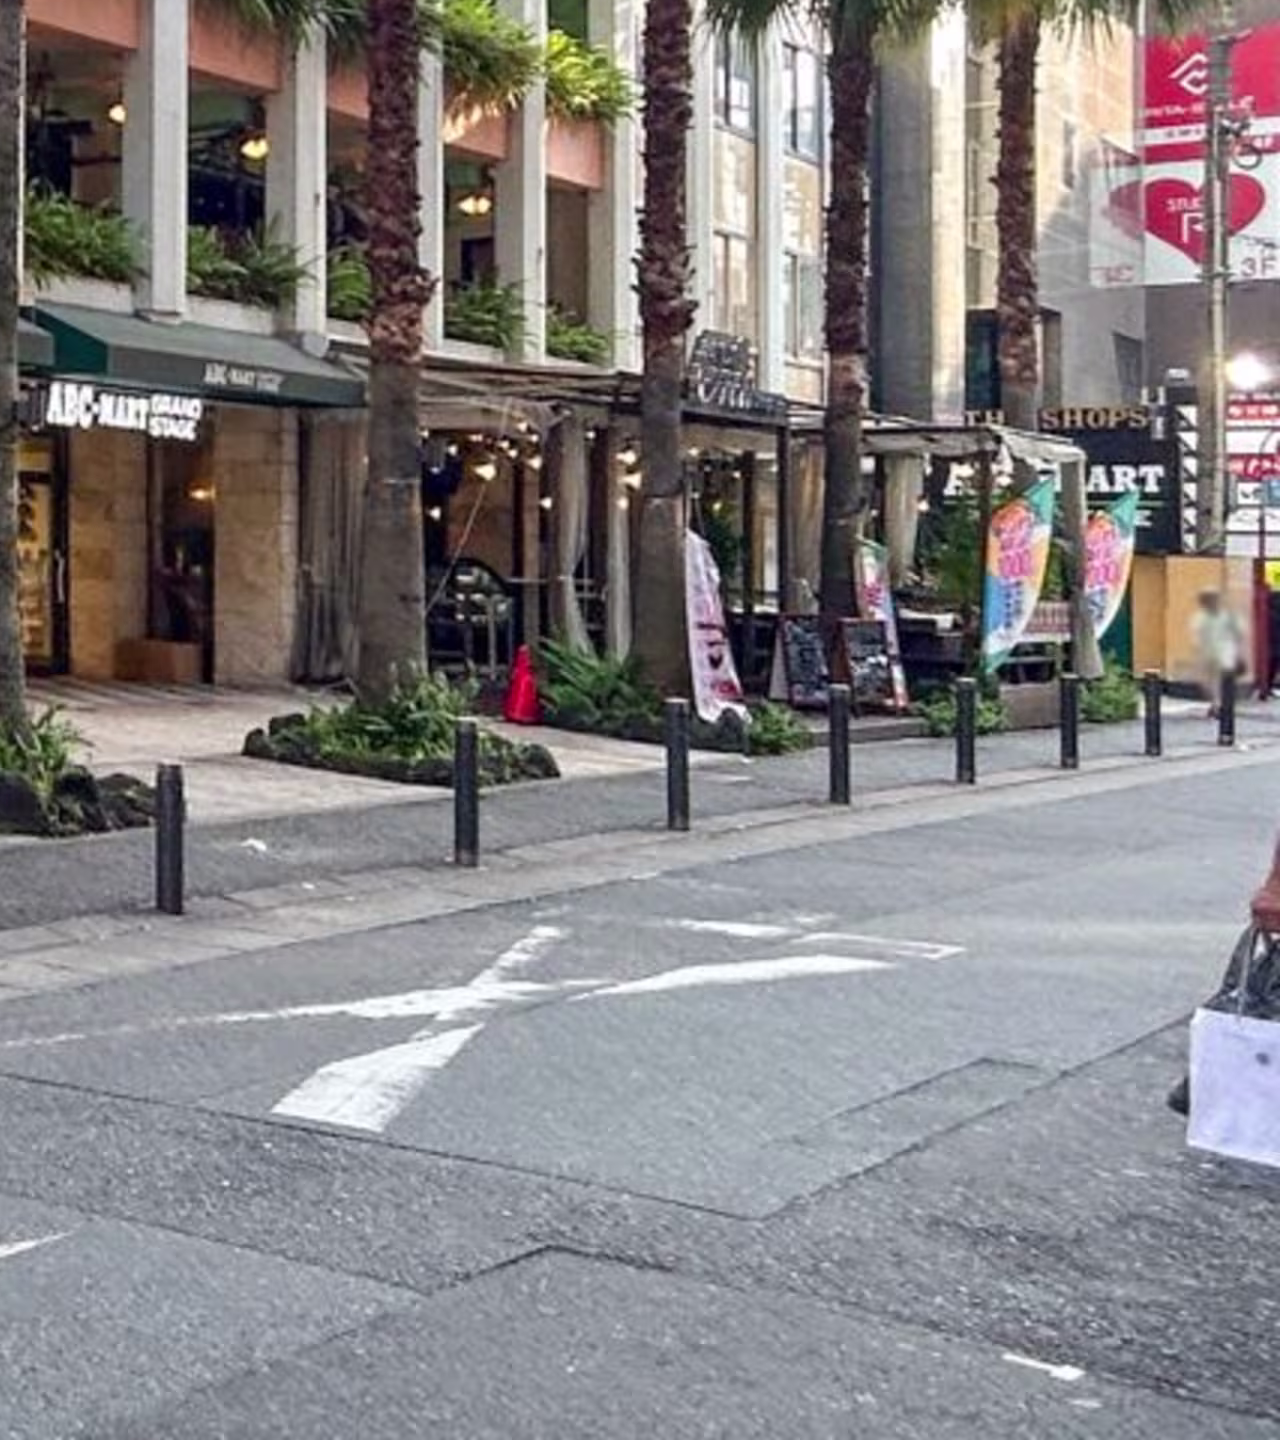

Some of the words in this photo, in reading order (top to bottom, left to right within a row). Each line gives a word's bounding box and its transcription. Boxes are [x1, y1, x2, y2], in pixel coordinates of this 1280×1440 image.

[151, 394, 202, 421] GRAND
[963, 409, 1005, 428] TH
[1040, 407, 1148, 431] SHOPS
[149, 417, 196, 441] STAGE
